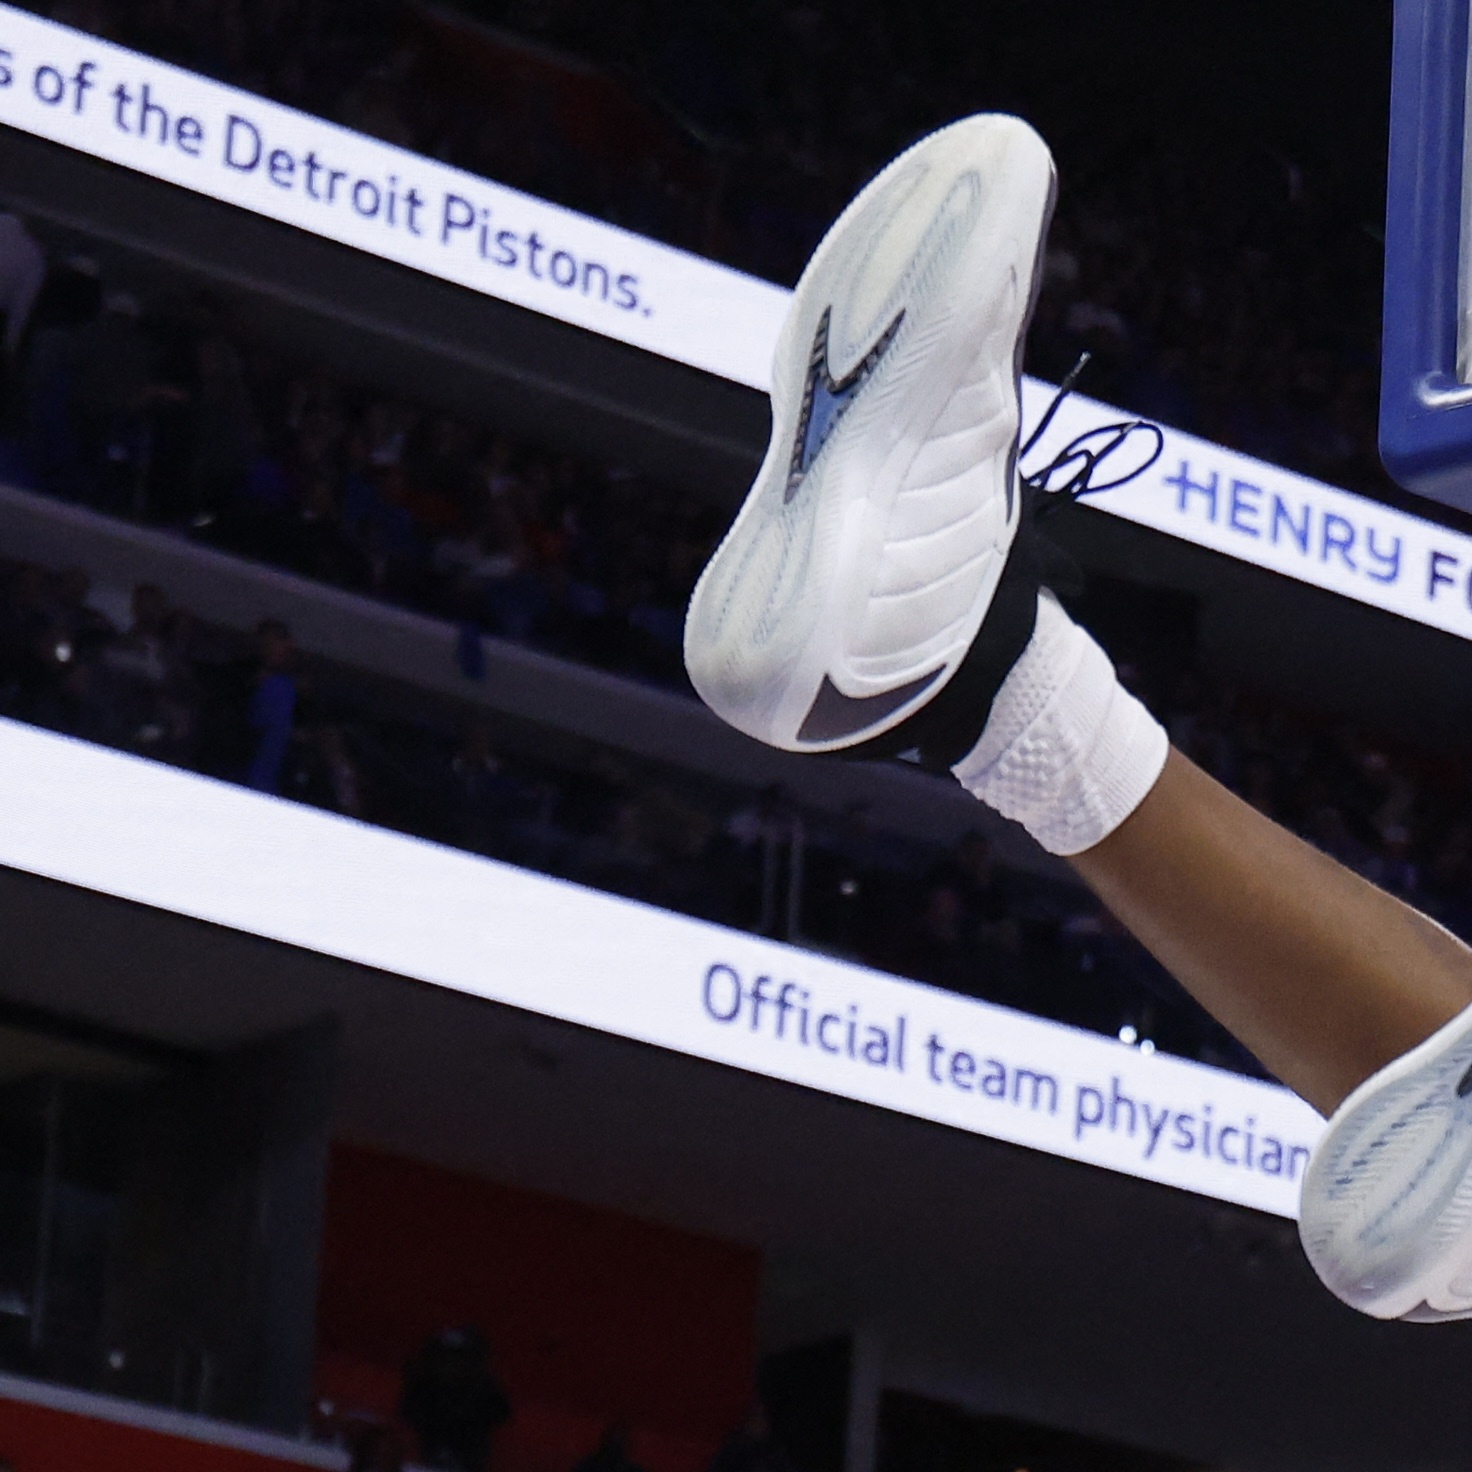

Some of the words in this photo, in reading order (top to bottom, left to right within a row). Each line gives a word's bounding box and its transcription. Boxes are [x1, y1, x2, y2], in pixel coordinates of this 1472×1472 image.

[34, 61, 95, 113] of
[113, 82, 204, 156] the
[224, 113, 423, 236] Detroit
[441, 192, 653, 318] Pistons.
[1164, 460, 1402, 583] HENRY
[703, 962, 907, 1072] Official
[927, 1034, 1058, 1114] team
